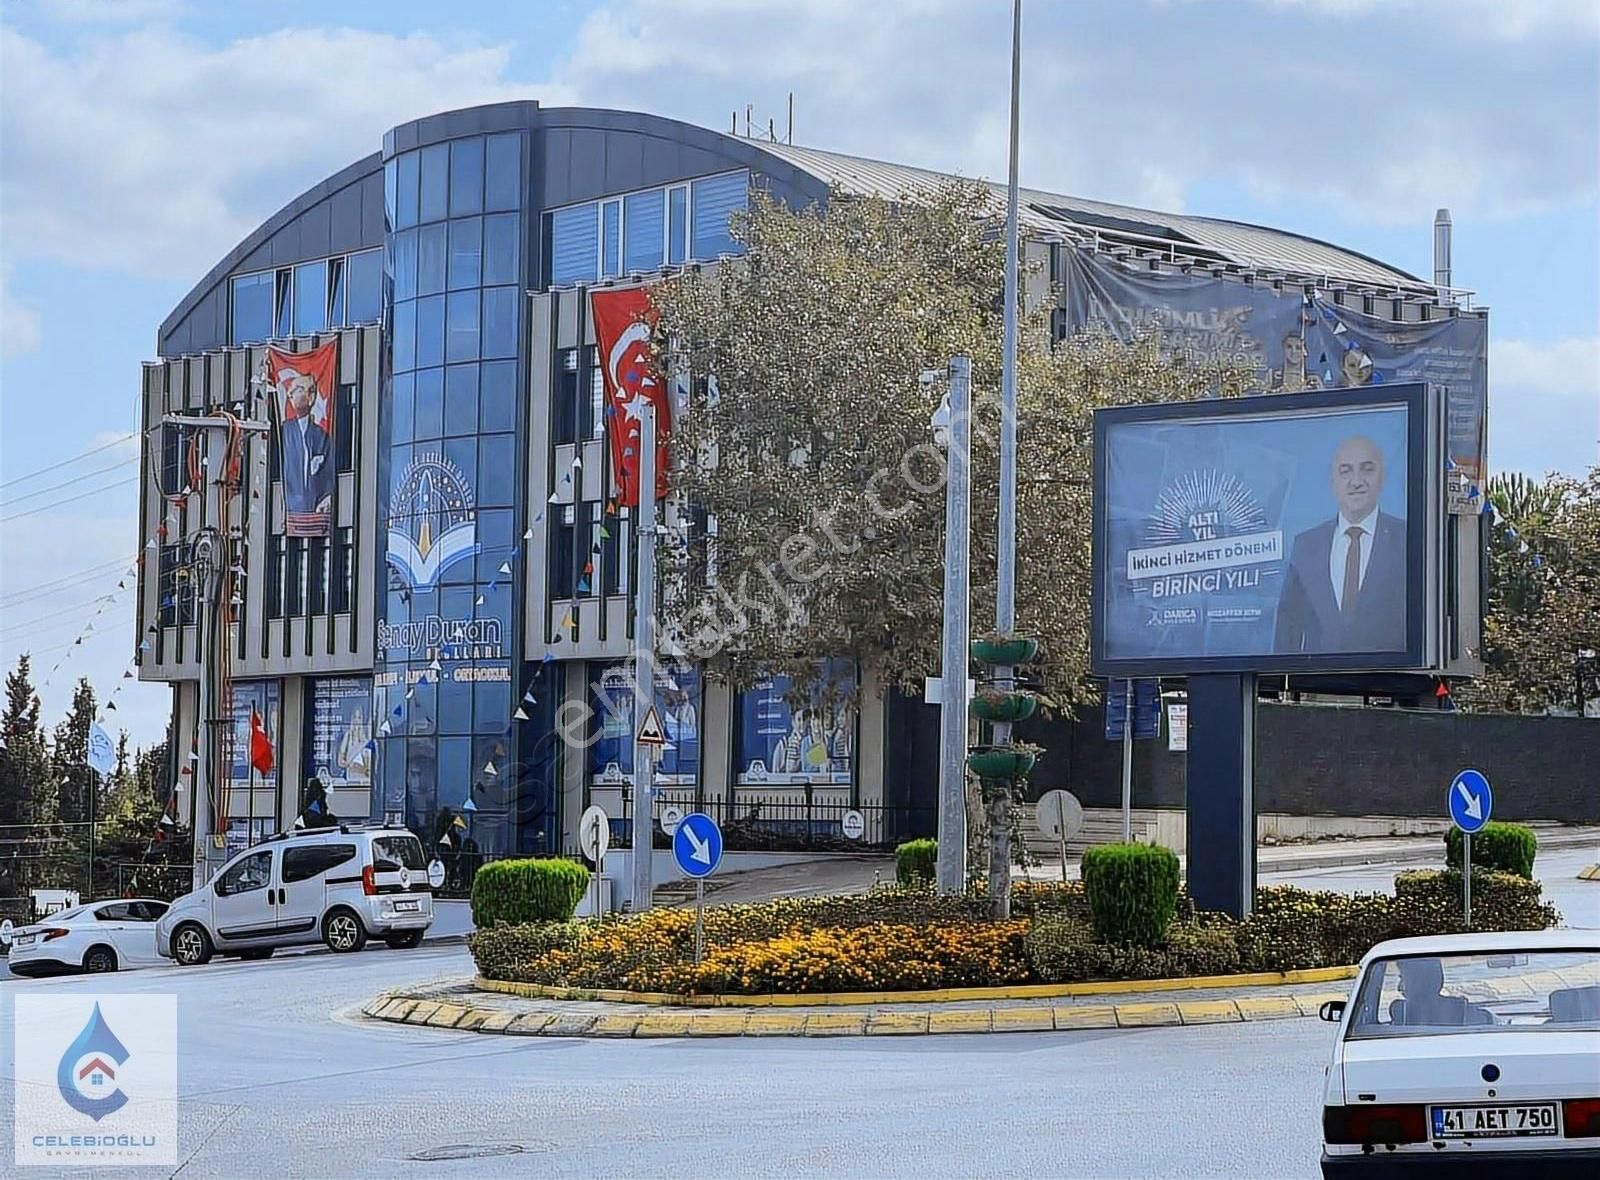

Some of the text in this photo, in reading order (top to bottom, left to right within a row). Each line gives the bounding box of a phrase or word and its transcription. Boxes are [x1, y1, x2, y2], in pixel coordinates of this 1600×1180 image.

[1187, 511, 1218, 527] ALTI
[1191, 526, 1217, 541] YIL
[1132, 537, 1276, 570] İKİNCİ HİZMET DÖNEMİ
[1152, 568, 1260, 598] BİRİNCİ YILI
[1444, 1108, 1551, 1130] 41 AET 750
